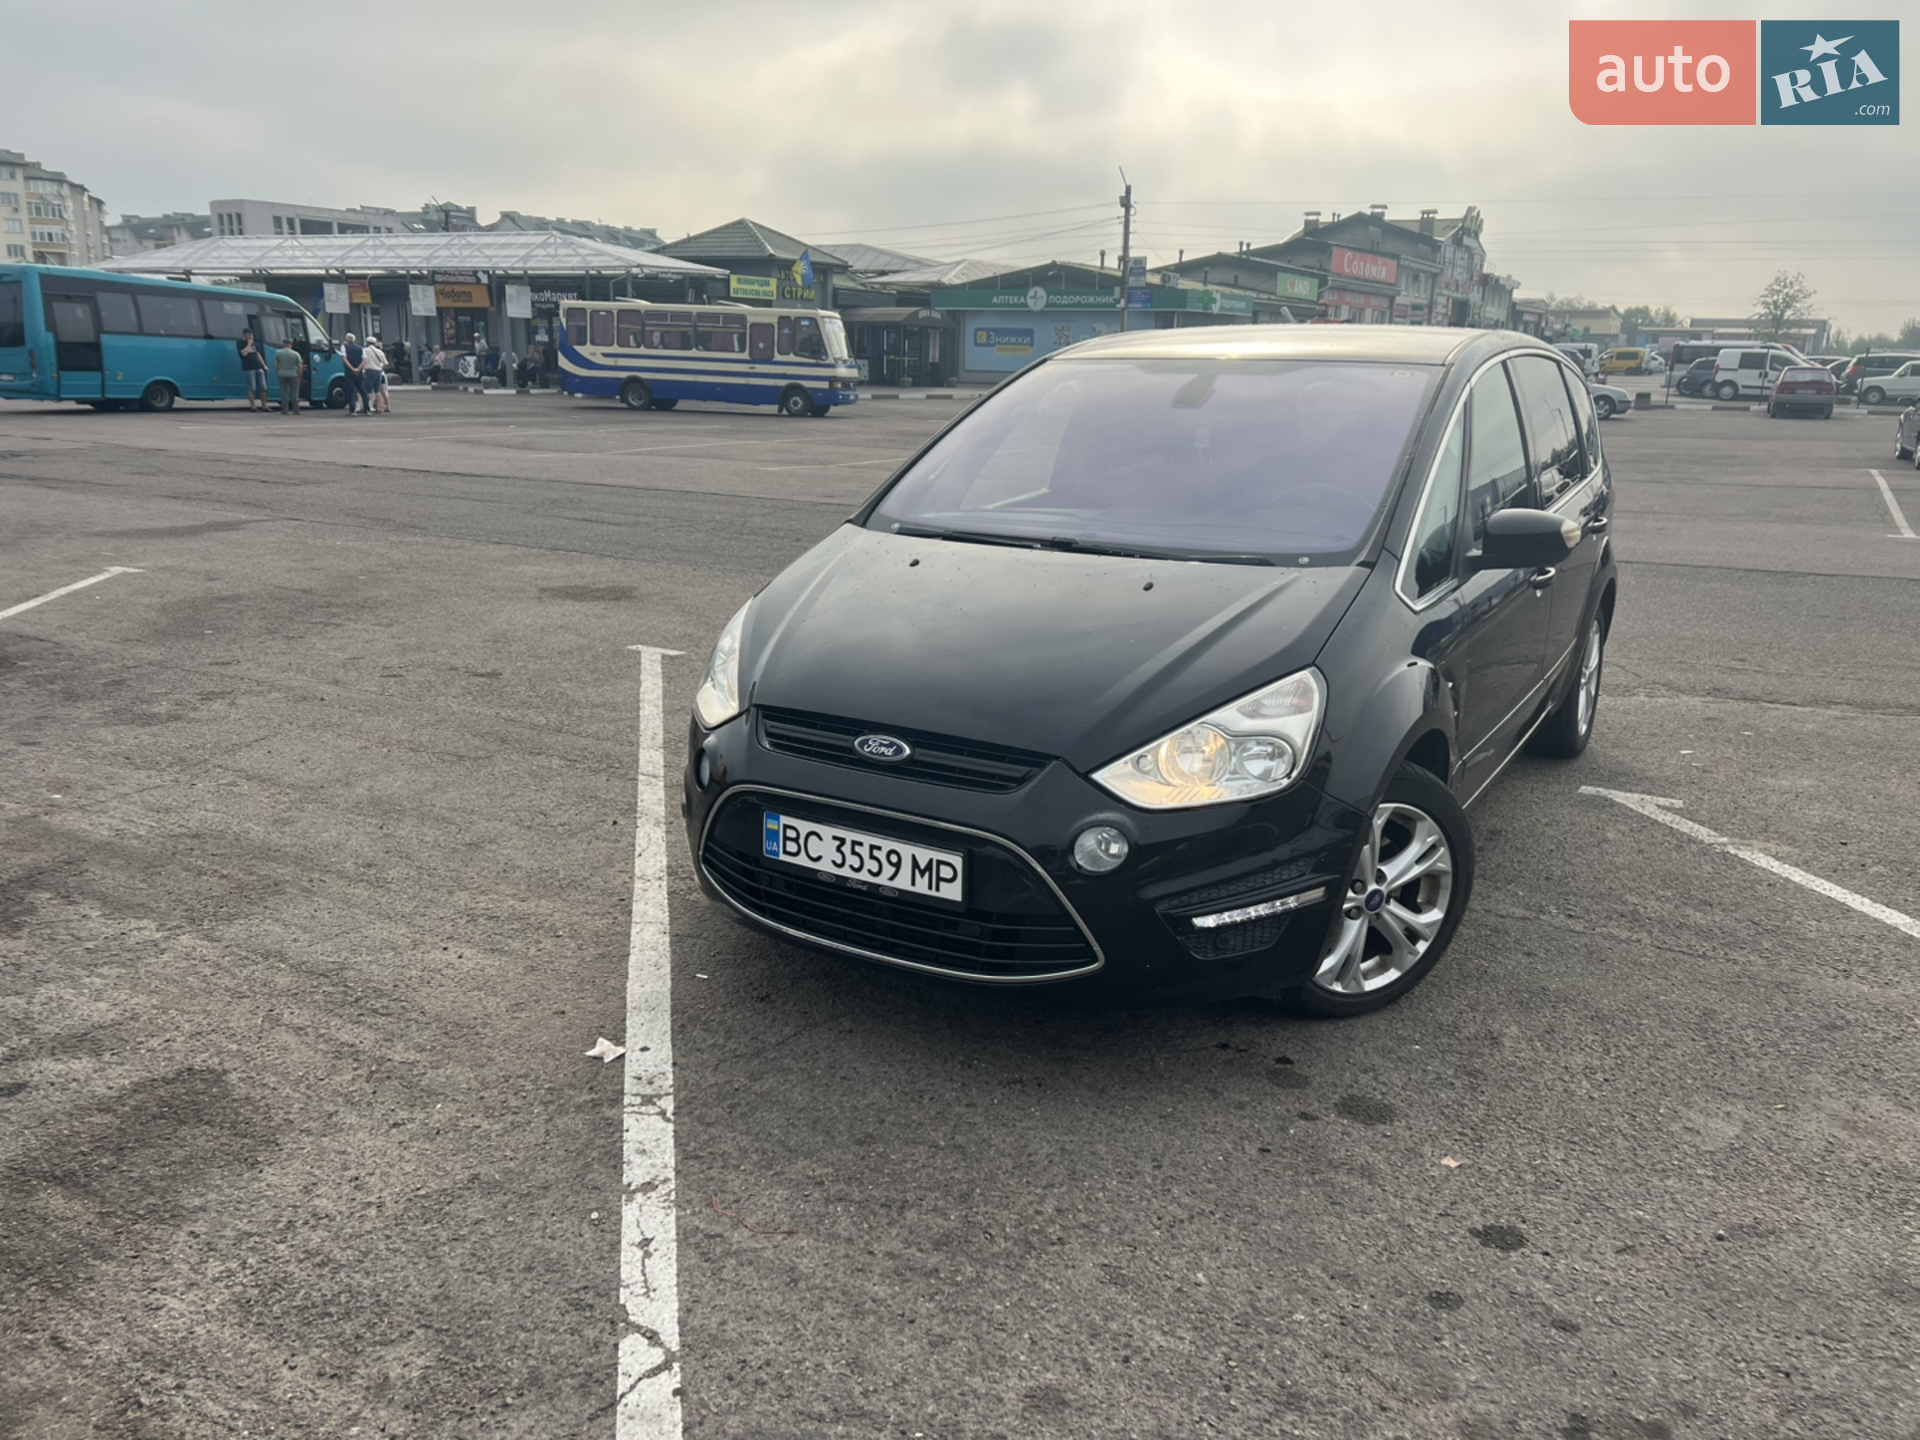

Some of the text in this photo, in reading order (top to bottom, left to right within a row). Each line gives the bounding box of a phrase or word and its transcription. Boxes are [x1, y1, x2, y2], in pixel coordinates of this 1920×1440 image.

[1343, 251, 1388, 280] Соломія
[531, 289, 578, 302] лкоМаркет
[784, 285, 816, 300] СТРИЙ
[991, 294, 1026, 305] АПТЕКА
[1048, 294, 1115, 305] ПОДОРОЖНИК
[988, 331, 1031, 345] Знижки
[863, 738, 896, 755] Ford
[765, 840, 779, 853] UA
[782, 823, 959, 893] BC 3559 MP
